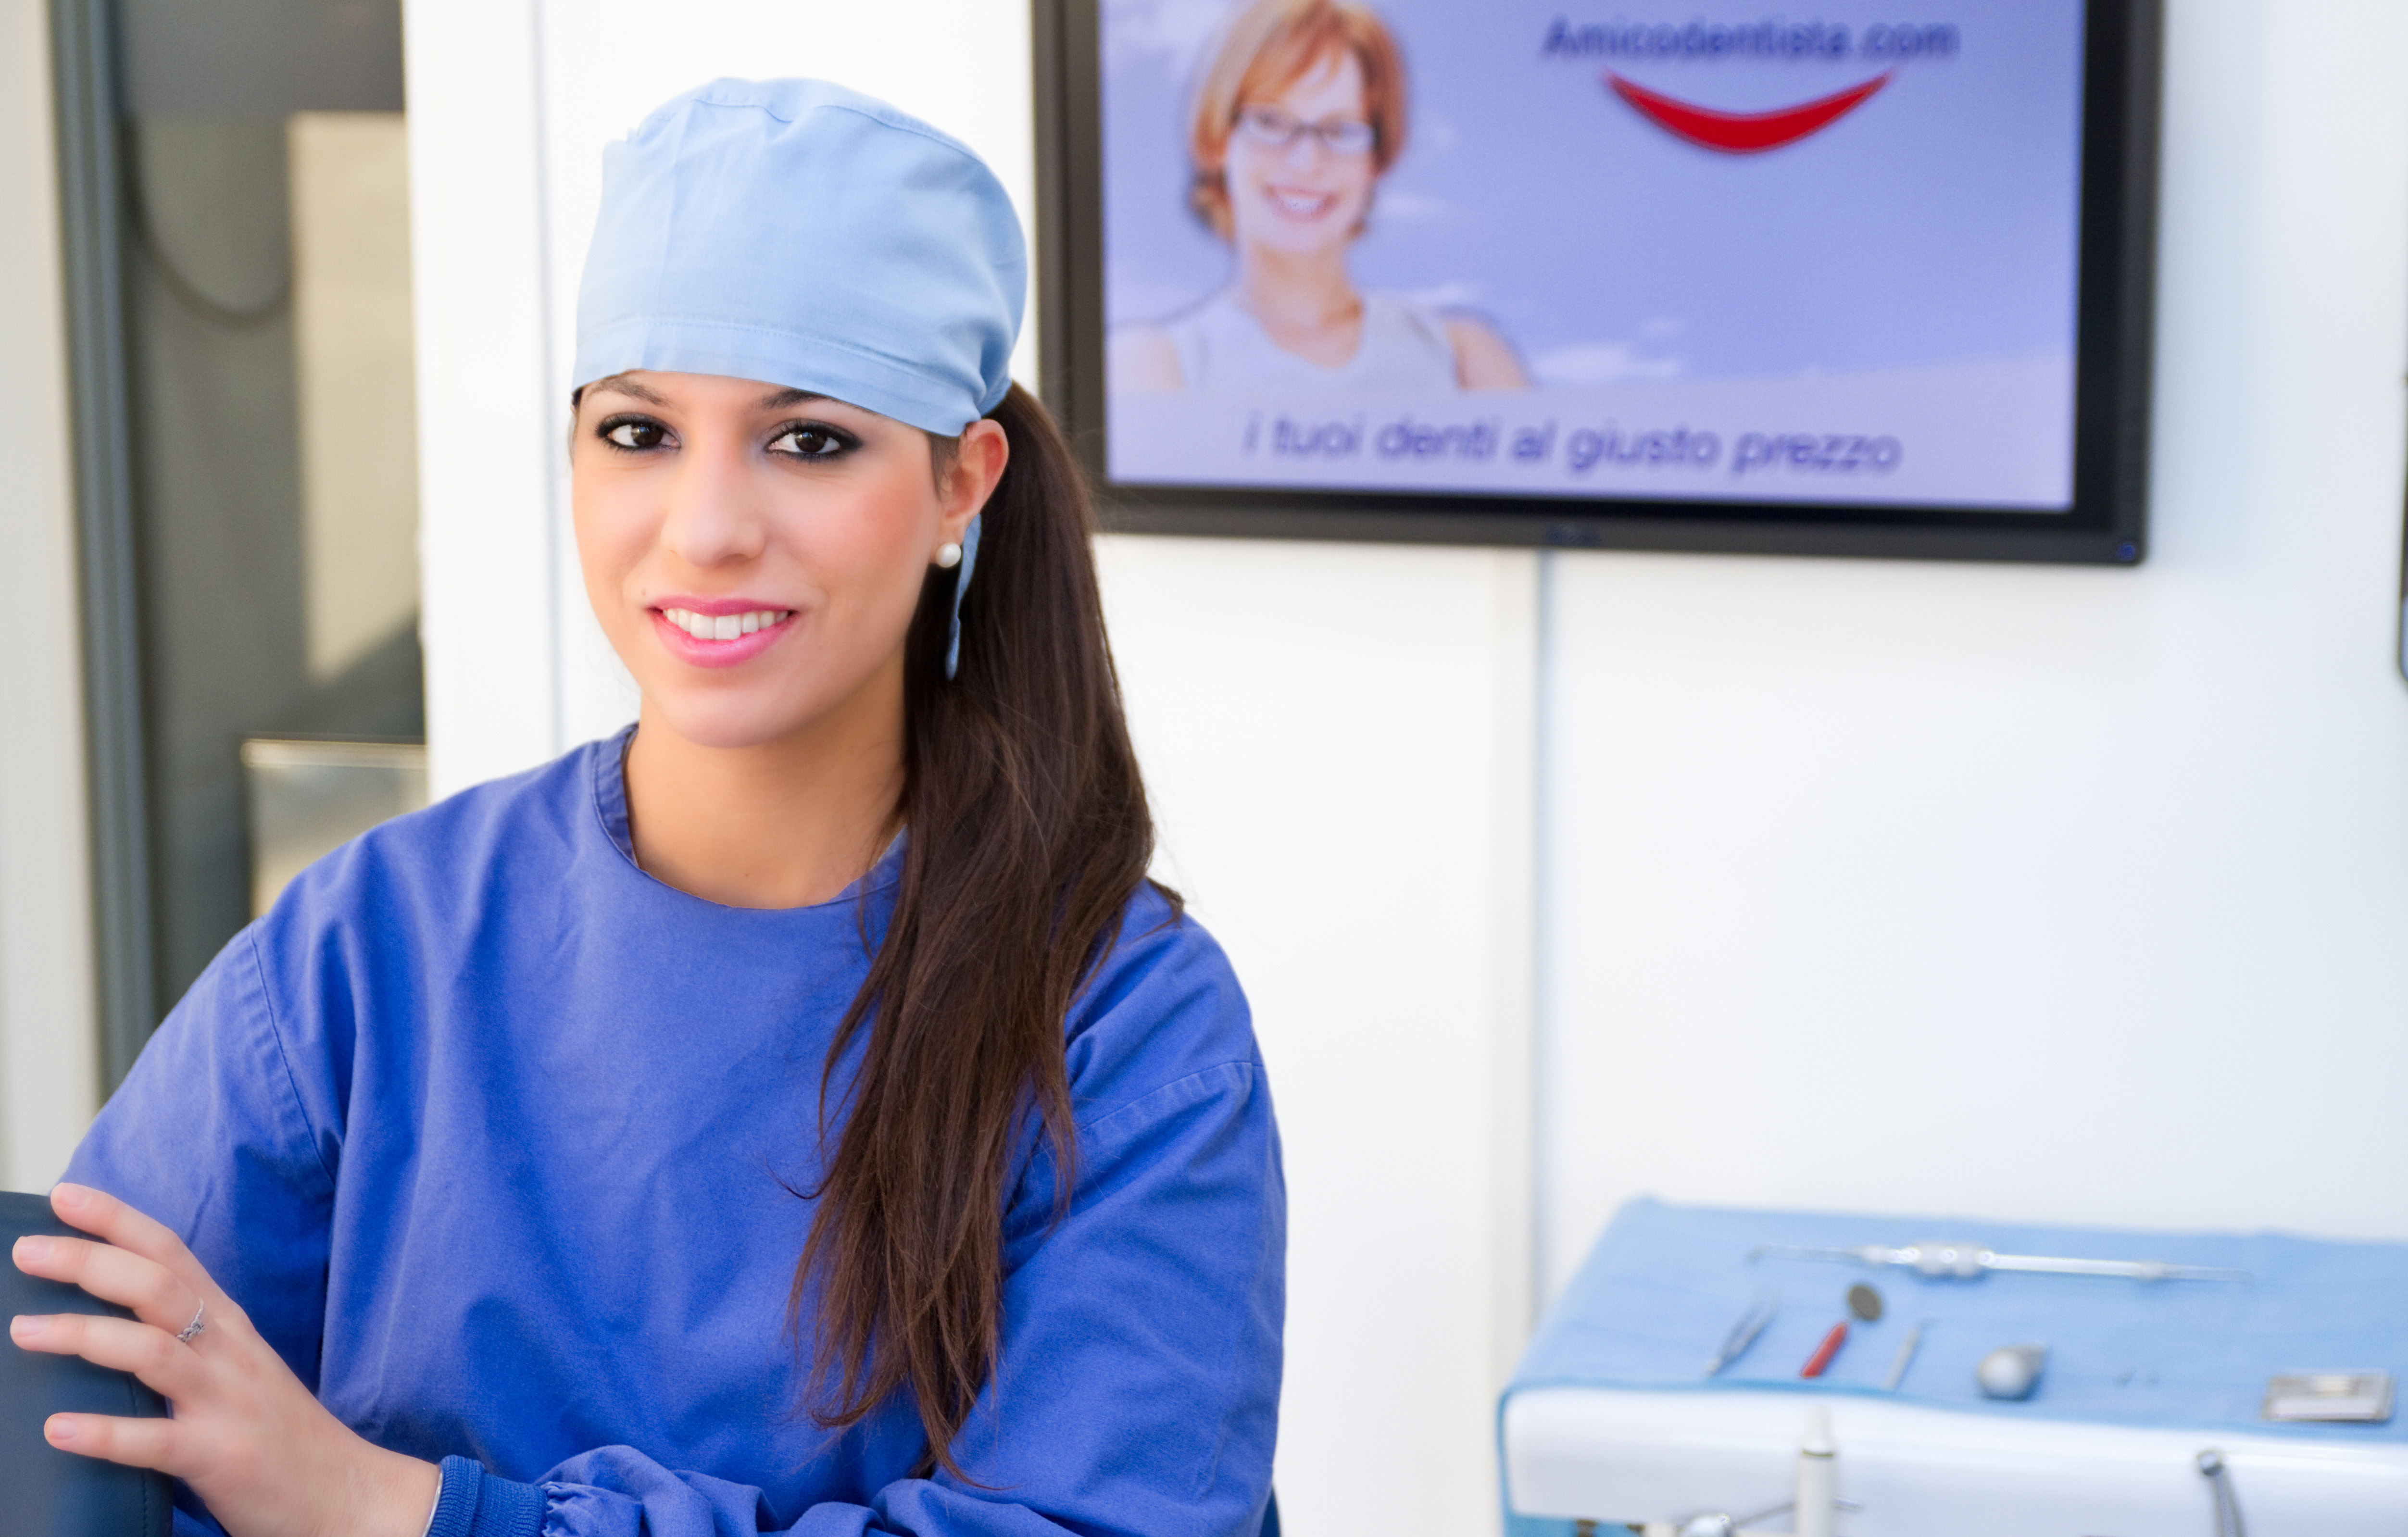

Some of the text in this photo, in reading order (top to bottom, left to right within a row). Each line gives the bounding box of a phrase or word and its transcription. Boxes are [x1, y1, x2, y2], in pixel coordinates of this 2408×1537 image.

[1273, 412, 1367, 457] tuoi
[1373, 413, 1503, 461] denti
[1509, 416, 1559, 462] al
[1565, 417, 1722, 479] giusto
[1731, 431, 1903, 480] prezzo
